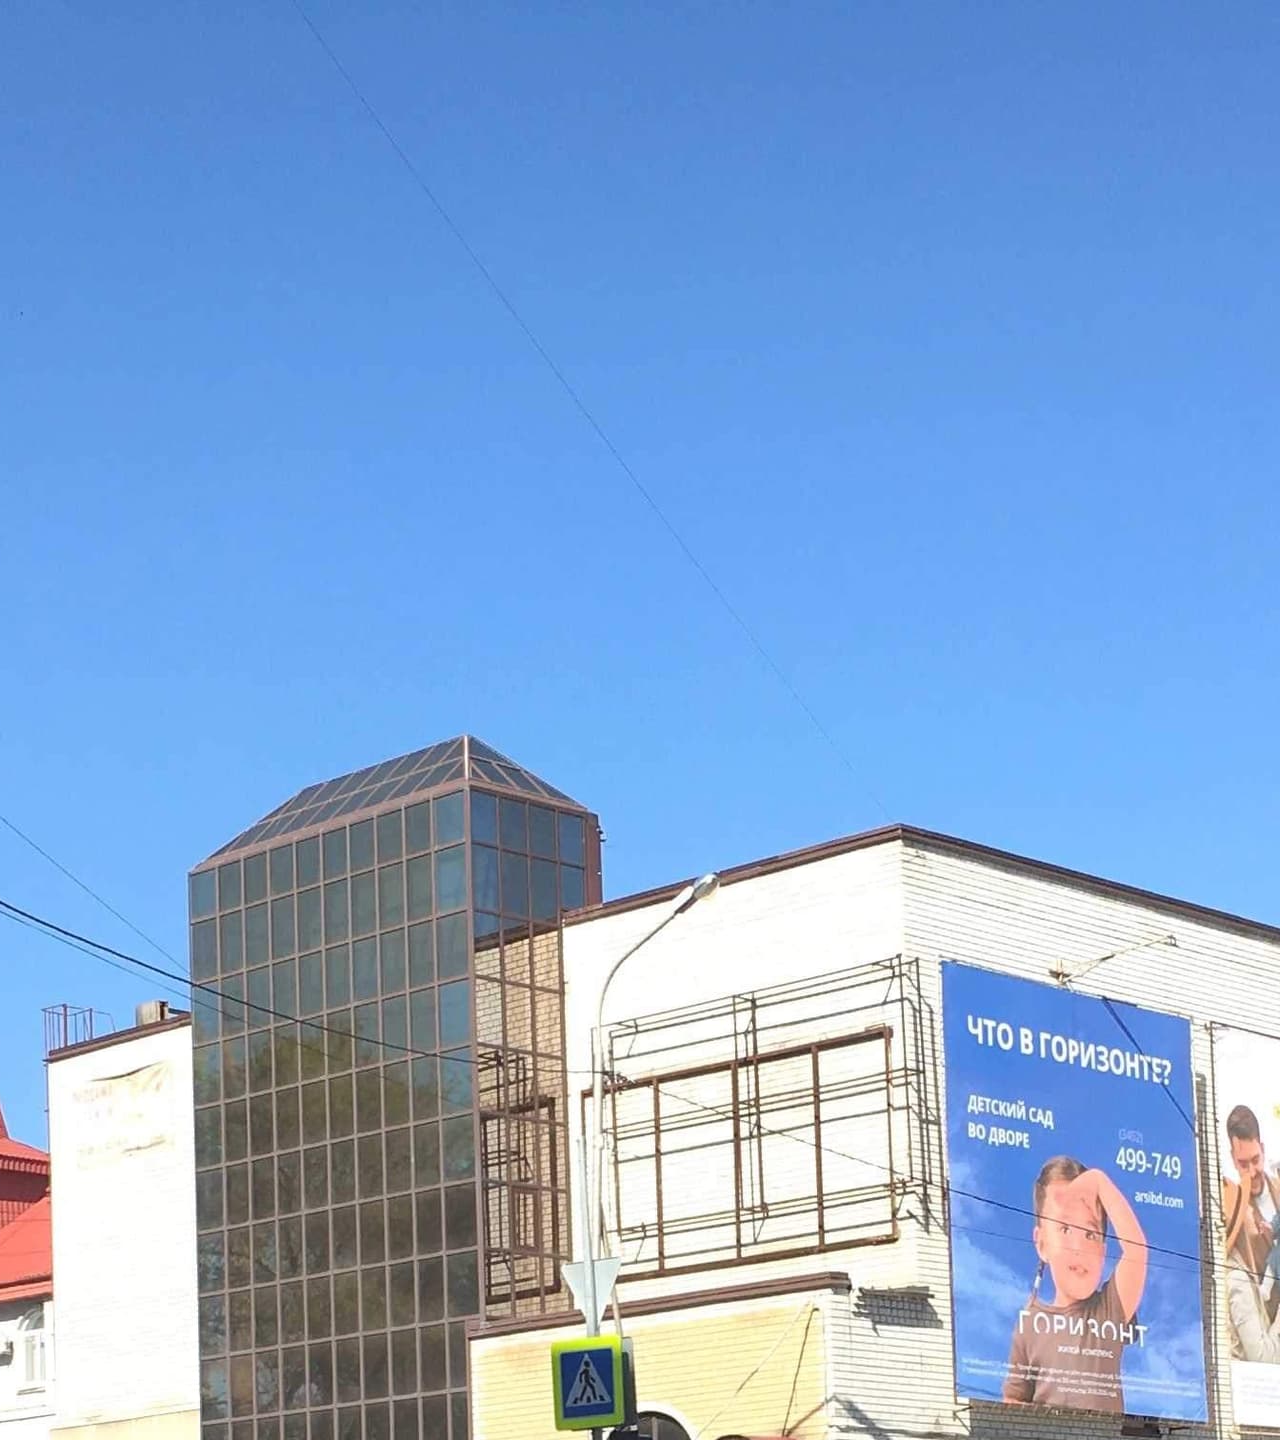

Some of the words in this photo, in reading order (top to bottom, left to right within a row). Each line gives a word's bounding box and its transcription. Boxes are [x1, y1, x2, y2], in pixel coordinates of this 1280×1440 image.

[967, 1015, 1014, 1051] ЧТО
[1019, 1028, 1034, 1055] В
[1039, 1031, 1172, 1085] ГОРИЗОНТЕ?
[967, 1094, 1026, 1122] ДЕТСКИЙ
[1028, 1107, 1055, 1130] САД
[968, 1122, 986, 1141] ВО
[988, 1128, 1030, 1149] ДВОРЕ
[1116, 1146, 1182, 1180] 499-749
[1134, 1191, 1184, 1209] arsibd.com
[1018, 1310, 1149, 1347] ГОРИЗОНТ
